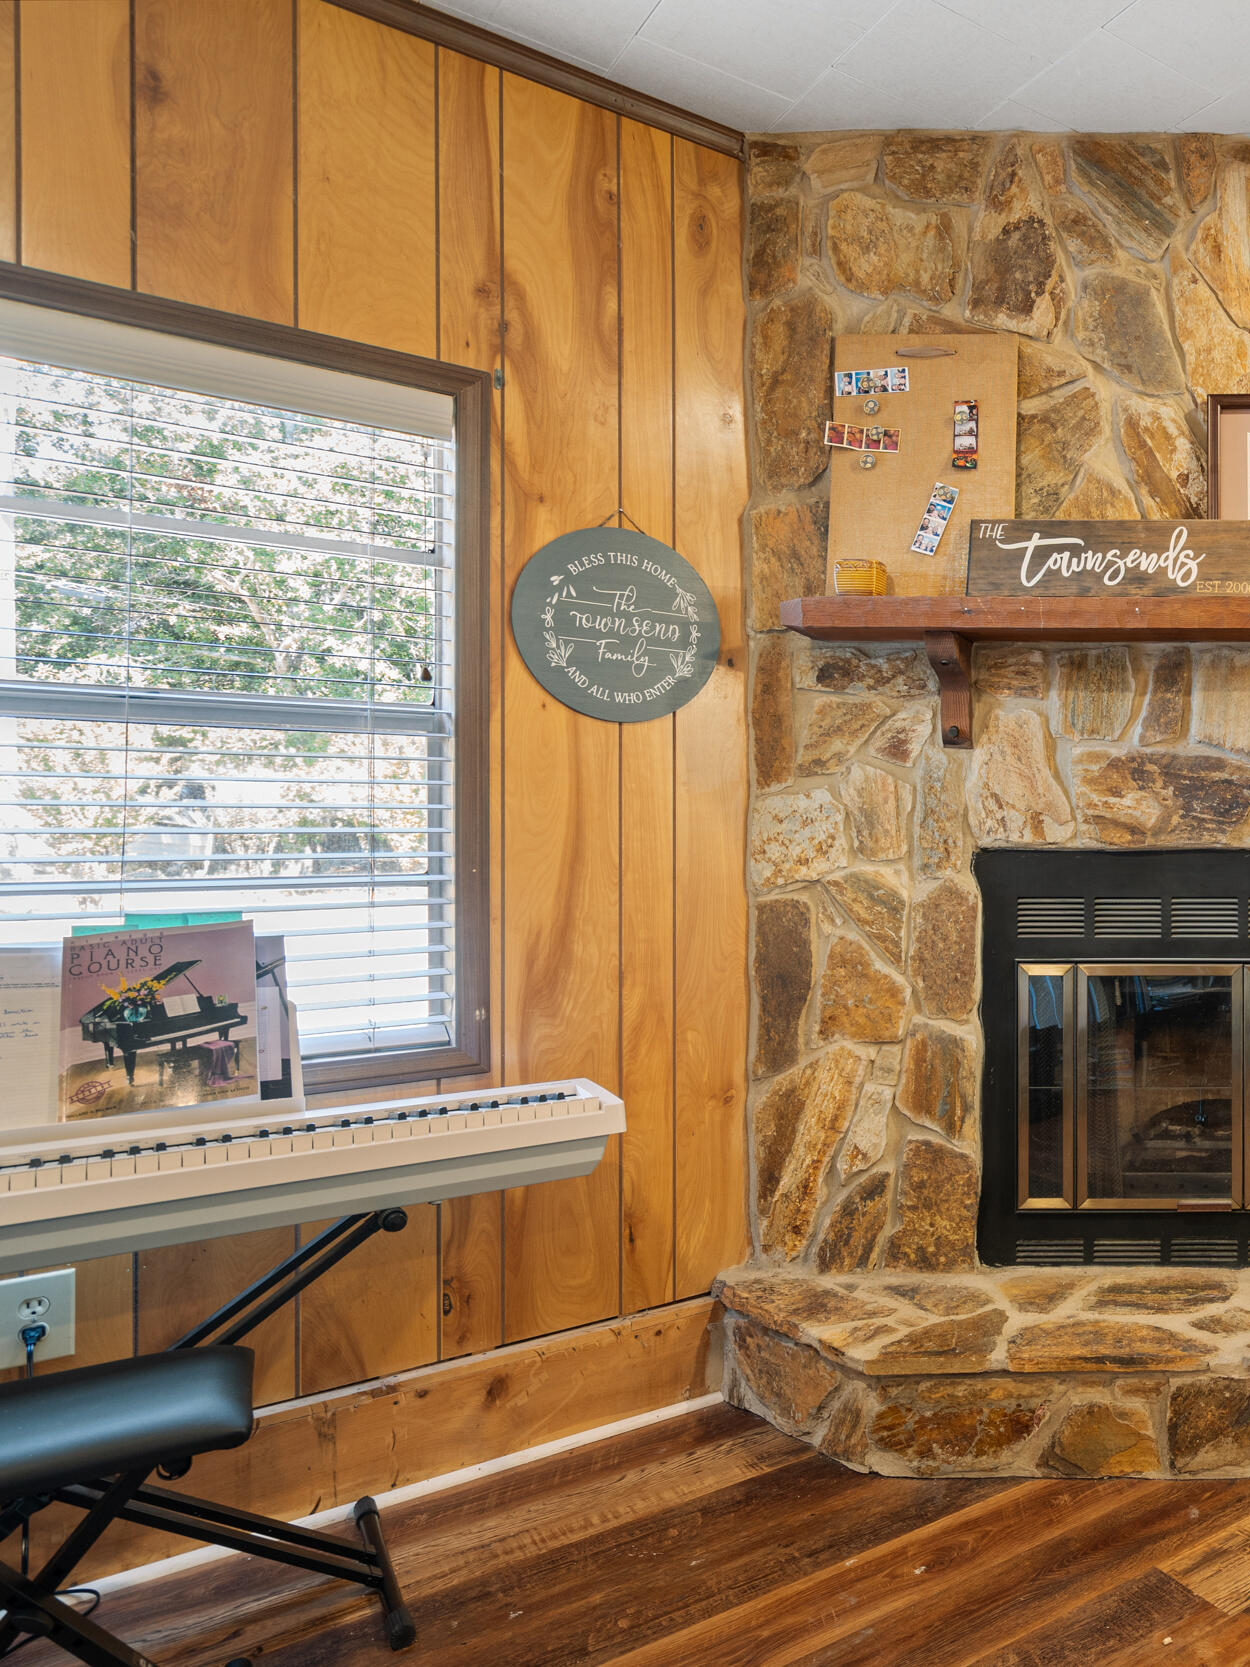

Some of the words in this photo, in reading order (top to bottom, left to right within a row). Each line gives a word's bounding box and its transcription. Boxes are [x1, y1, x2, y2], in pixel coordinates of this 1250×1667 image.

[979, 523, 1008, 540] THE
[567, 552, 605, 575] BLESS
[607, 552, 638, 567] THIS
[642, 560, 677, 588] HOME
[1196, 581, 1221, 593] EST
[592, 585, 653, 613] The
[595, 638, 657, 677] Family
[565, 665, 589, 689] AND
[588, 684, 611, 701] ALL
[614, 691, 643, 704] WHO
[645, 675, 677, 701] ENTER
[120, 935, 163, 947] ADULT
[70, 943, 164, 964] PIANO
[68, 955, 163, 976] COURSE
